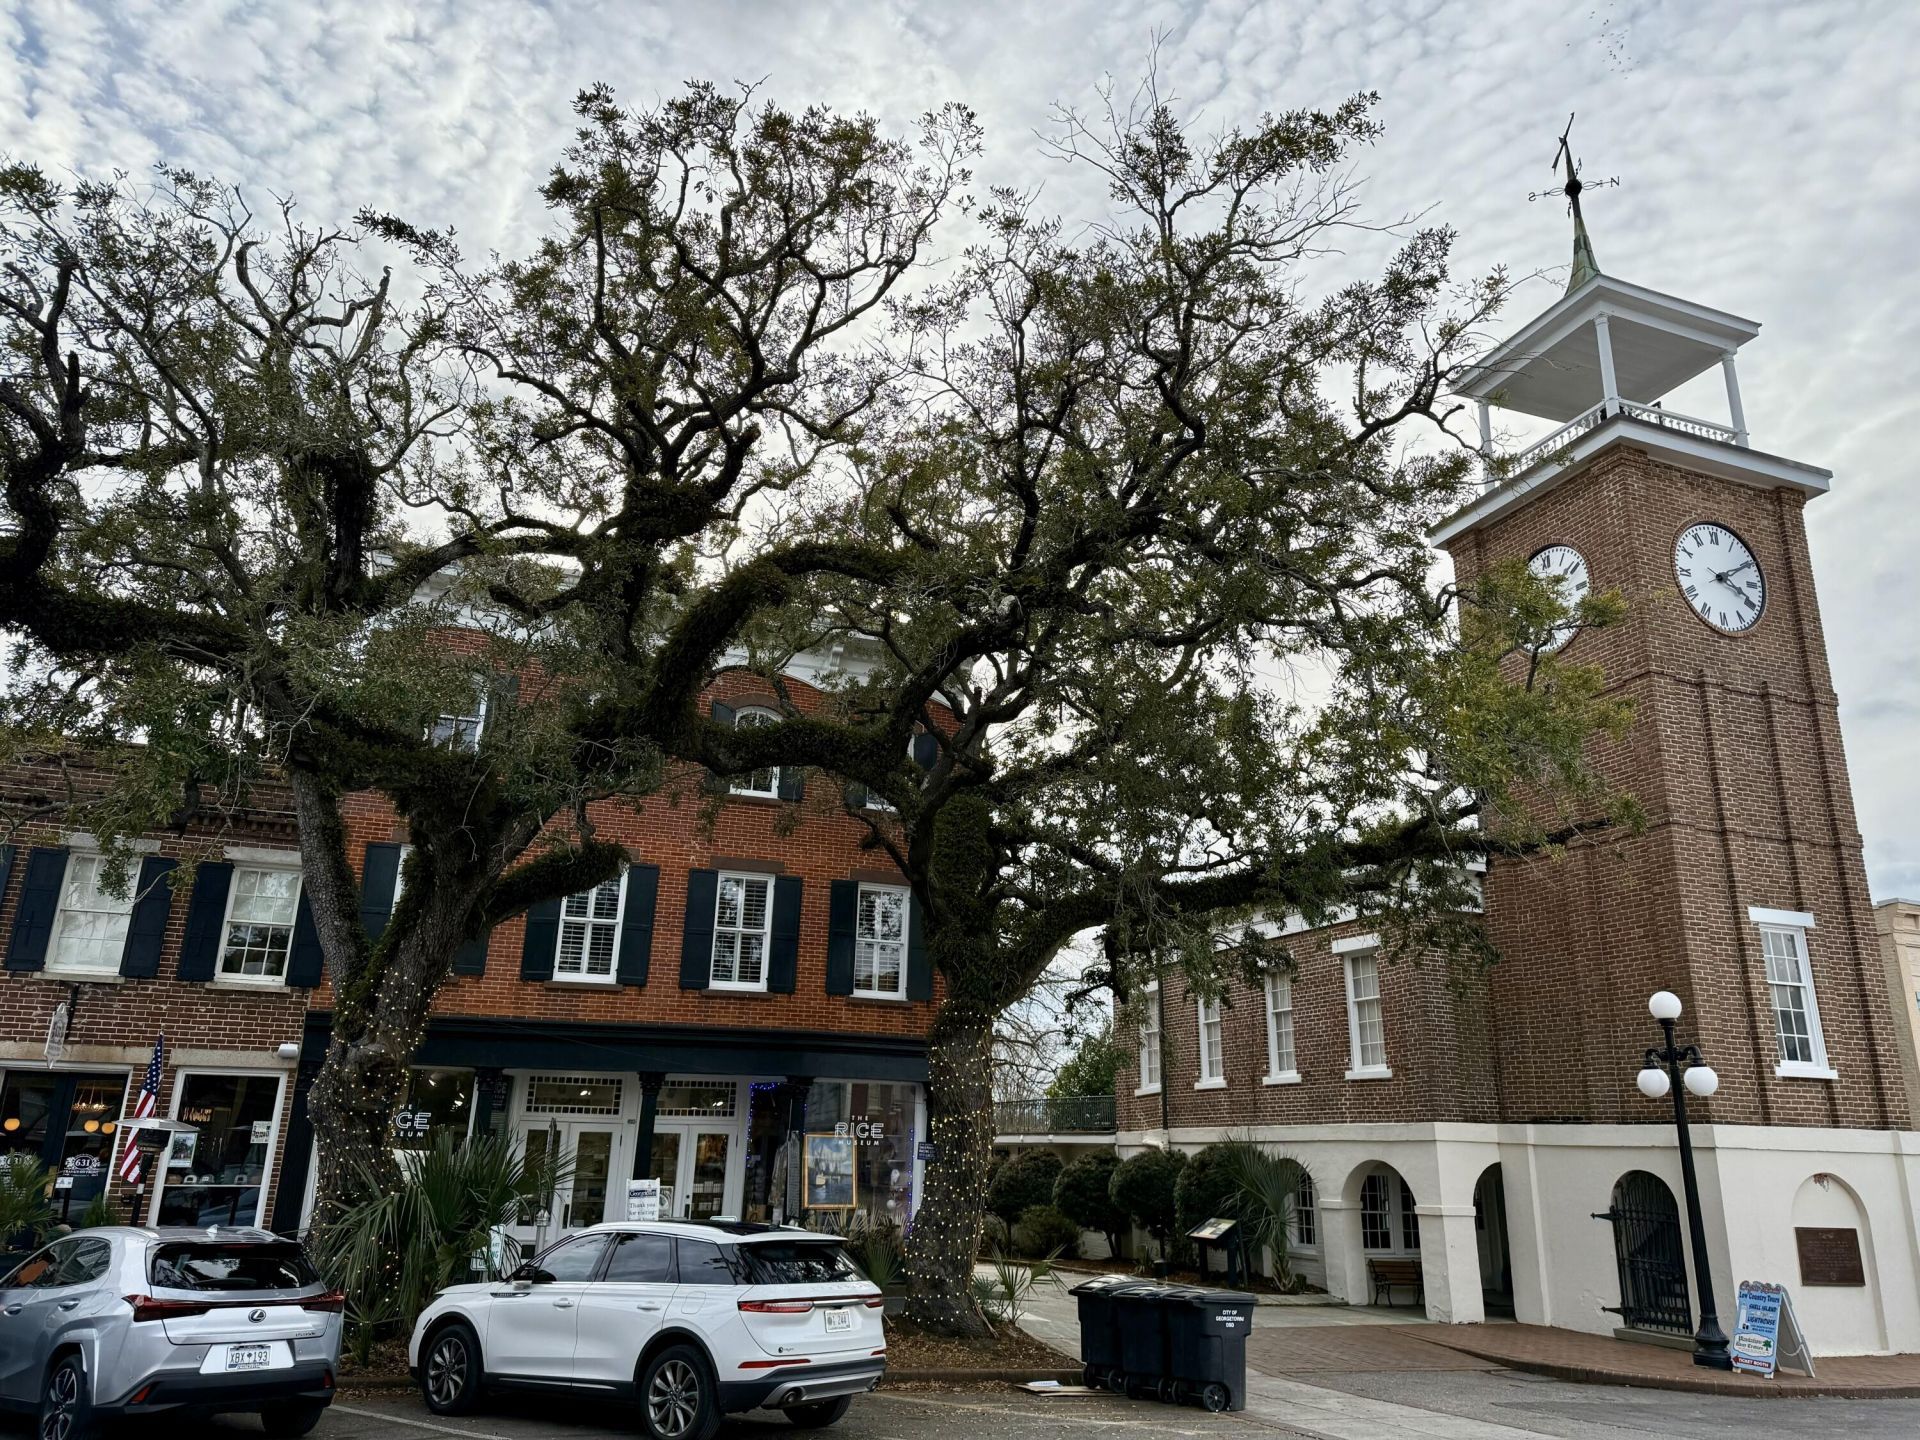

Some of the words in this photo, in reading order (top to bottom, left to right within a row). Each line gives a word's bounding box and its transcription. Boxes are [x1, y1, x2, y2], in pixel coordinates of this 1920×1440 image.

[1692, 532, 1704, 548] XI
[1709, 531, 1719, 545] XII
[1681, 546, 1693, 558] X
[1679, 567, 1691, 577] IX
[1746, 581, 1758, 589] III
[1685, 585, 1699, 601] VIII
[1701, 602, 1711, 619] VII
[1736, 610, 1745, 624] V
[1720, 612, 1728, 627] VI
[396, 1112, 431, 1129] CE
[835, 1122, 884, 1138] RICE
[1749, 1293, 1766, 1302] Country
